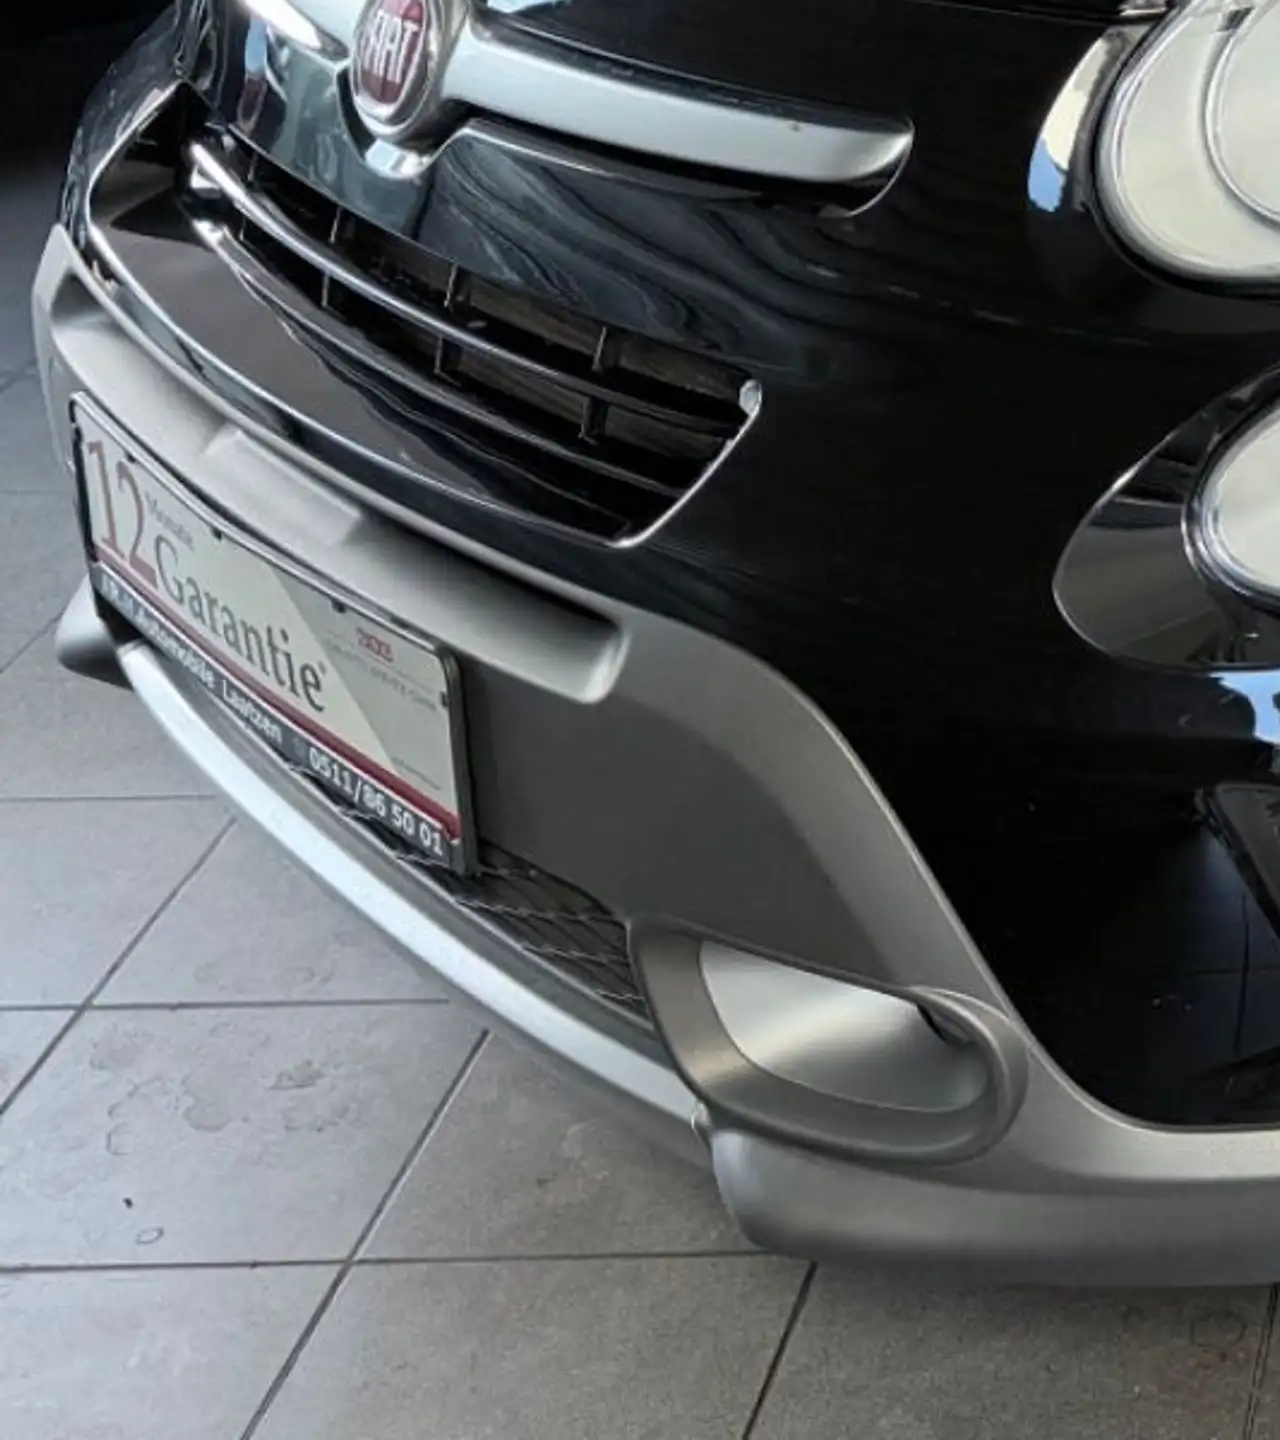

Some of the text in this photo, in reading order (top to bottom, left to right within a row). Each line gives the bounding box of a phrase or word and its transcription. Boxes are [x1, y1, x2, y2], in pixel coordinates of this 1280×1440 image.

[360, 9, 420, 84] FIAT
[87, 439, 159, 591] 12
[419, 821, 443, 857] 01
